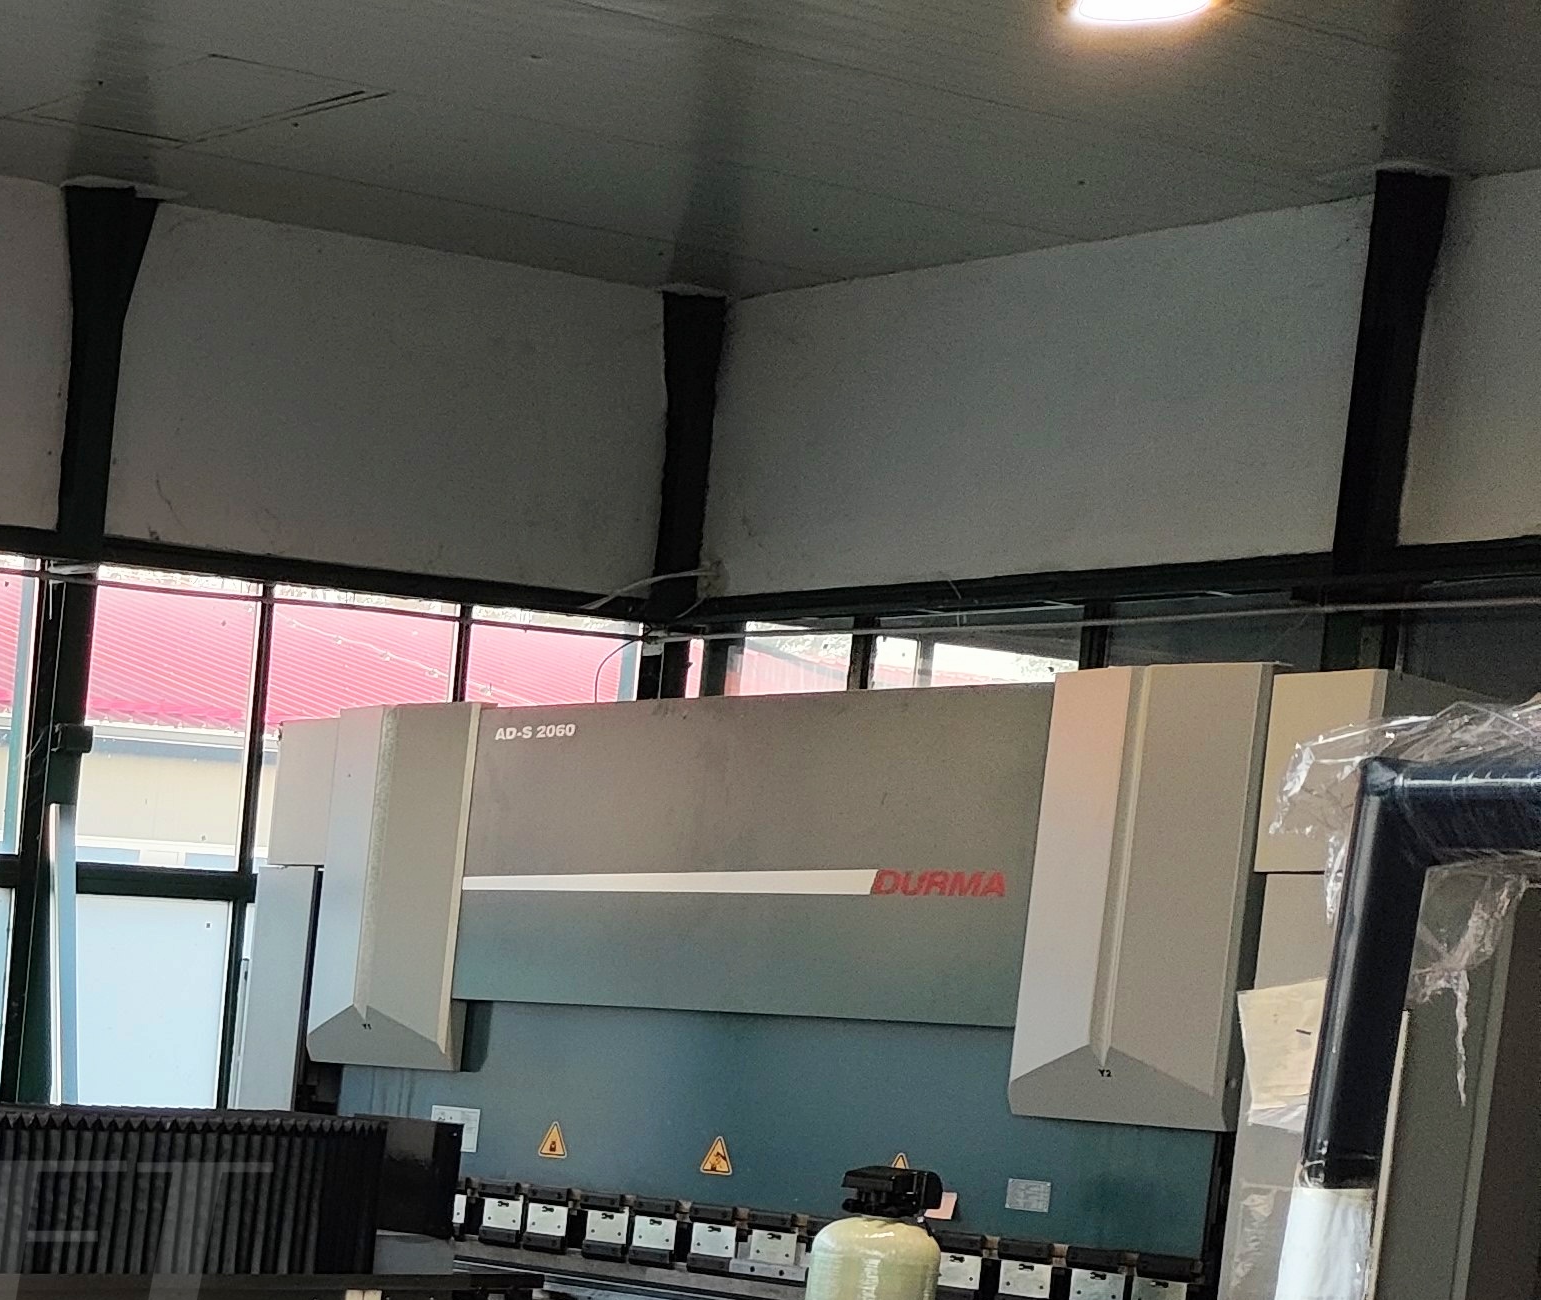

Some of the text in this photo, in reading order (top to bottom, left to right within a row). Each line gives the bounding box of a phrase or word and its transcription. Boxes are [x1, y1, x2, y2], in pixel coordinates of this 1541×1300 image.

[495, 724, 576, 740] AD-S 2060
[870, 869, 1005, 896] DURMA
[1098, 1069, 1112, 1077] Y2
